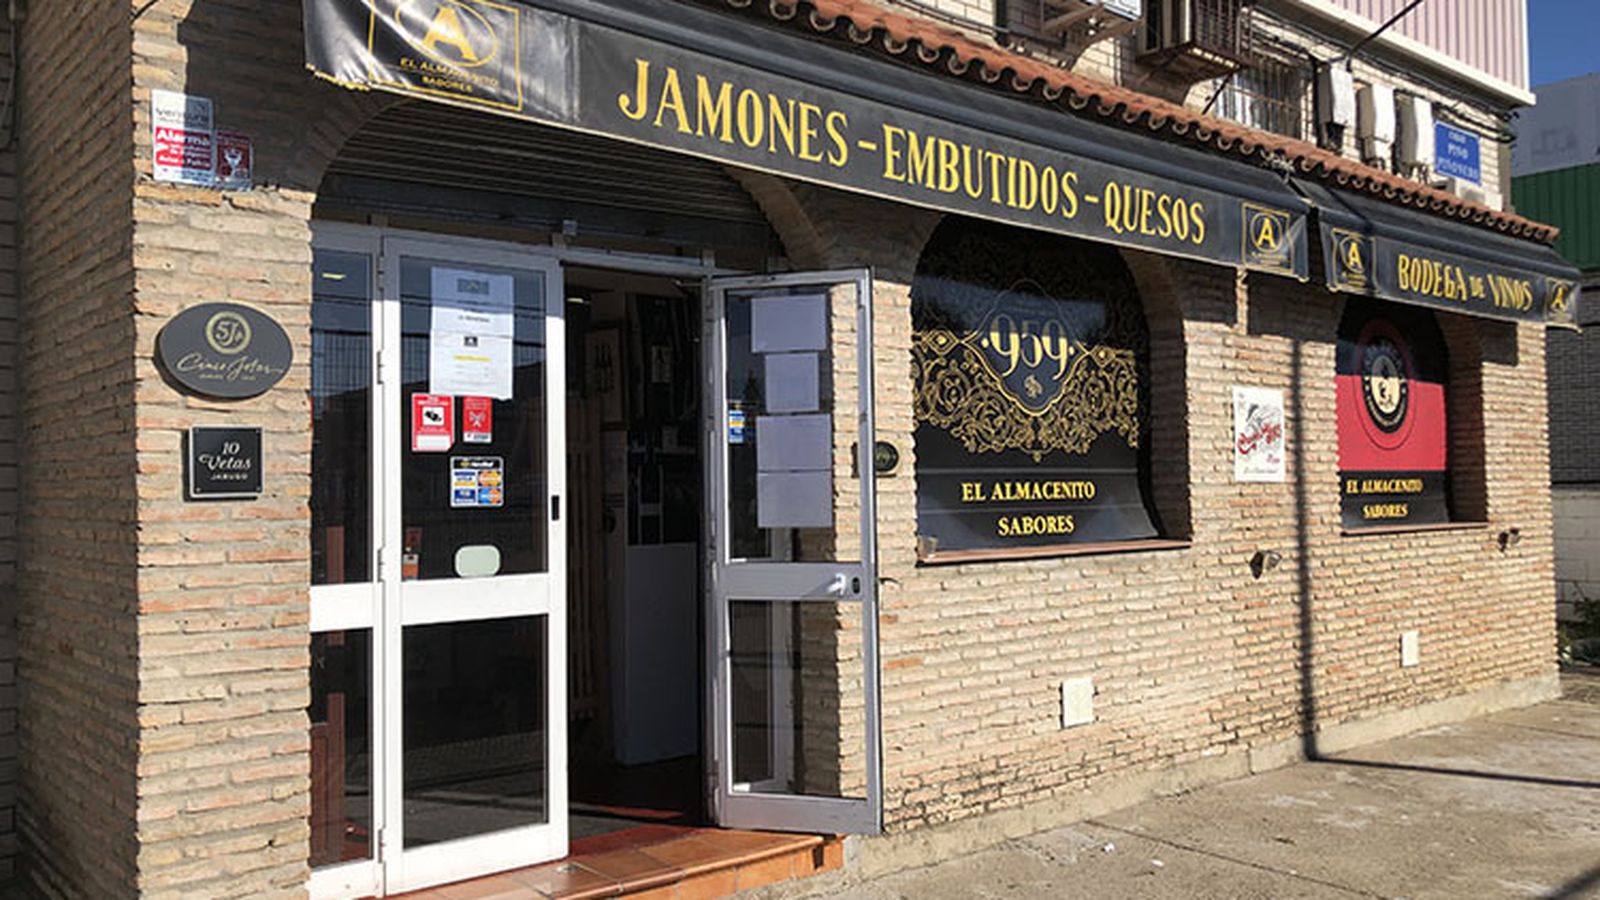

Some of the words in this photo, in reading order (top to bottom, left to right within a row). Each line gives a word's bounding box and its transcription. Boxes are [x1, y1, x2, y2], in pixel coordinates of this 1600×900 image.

[617, 57, 849, 168] JAMONES
[882, 123, 1079, 219] EMBUTIDOS
[1104, 181, 1206, 244] QUESOS
[1256, 217, 1276, 249] A
[1398, 253, 1468, 301] BODEGA
[1487, 273, 1533, 312] VINOS
[222, 441, 240, 455] 10
[961, 482, 986, 502] EL
[990, 480, 1096, 501] ALMACENITO
[1346, 479, 1359, 494] EL
[1361, 478, 1423, 494] ALMACENITO
[998, 515, 1076, 536] SABORES
